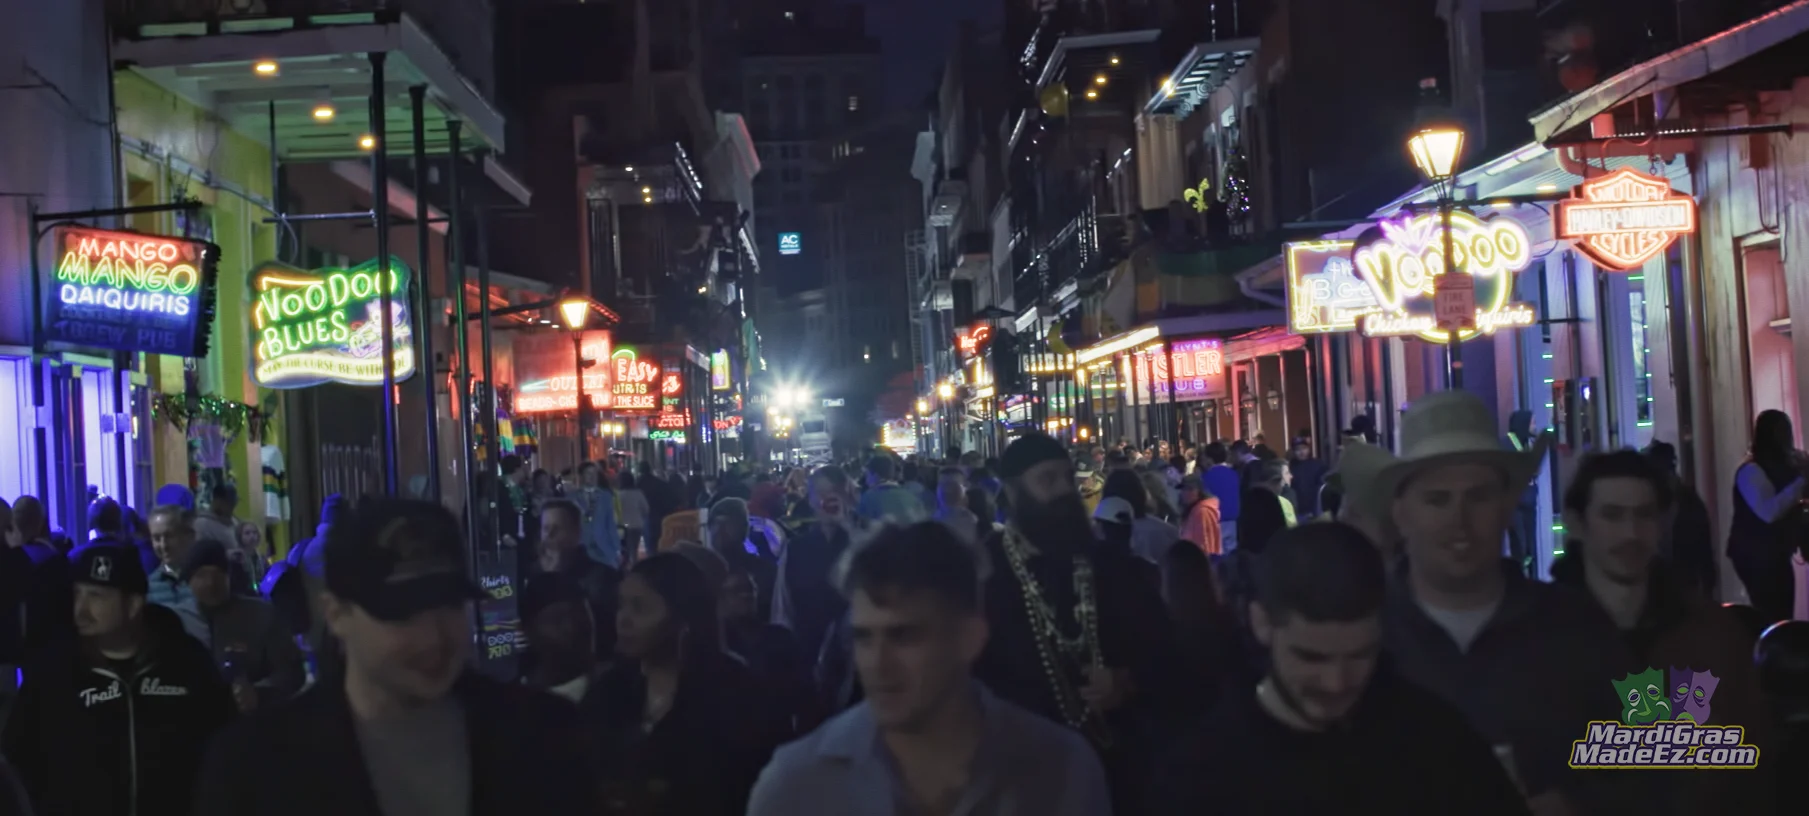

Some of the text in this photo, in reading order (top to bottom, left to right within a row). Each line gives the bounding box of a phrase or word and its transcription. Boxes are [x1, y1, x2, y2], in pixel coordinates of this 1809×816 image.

[78, 238, 177, 261] MANGO
[780, 234, 798, 245] AC
[1599, 231, 1659, 258] CYCLES
[58, 251, 197, 295] MANGO
[60, 283, 190, 316] DAIQUIRIS
[1443, 292, 1463, 302] FIRE
[1443, 305, 1467, 315] LANE
[1476, 305, 1533, 333] iquiris
[263, 309, 349, 358] BLUES
[338, 363, 351, 374] BE
[617, 358, 658, 382] EASY
[617, 396, 632, 406] THE
[632, 396, 654, 406] SLICE
[79, 680, 122, 708] Trail
